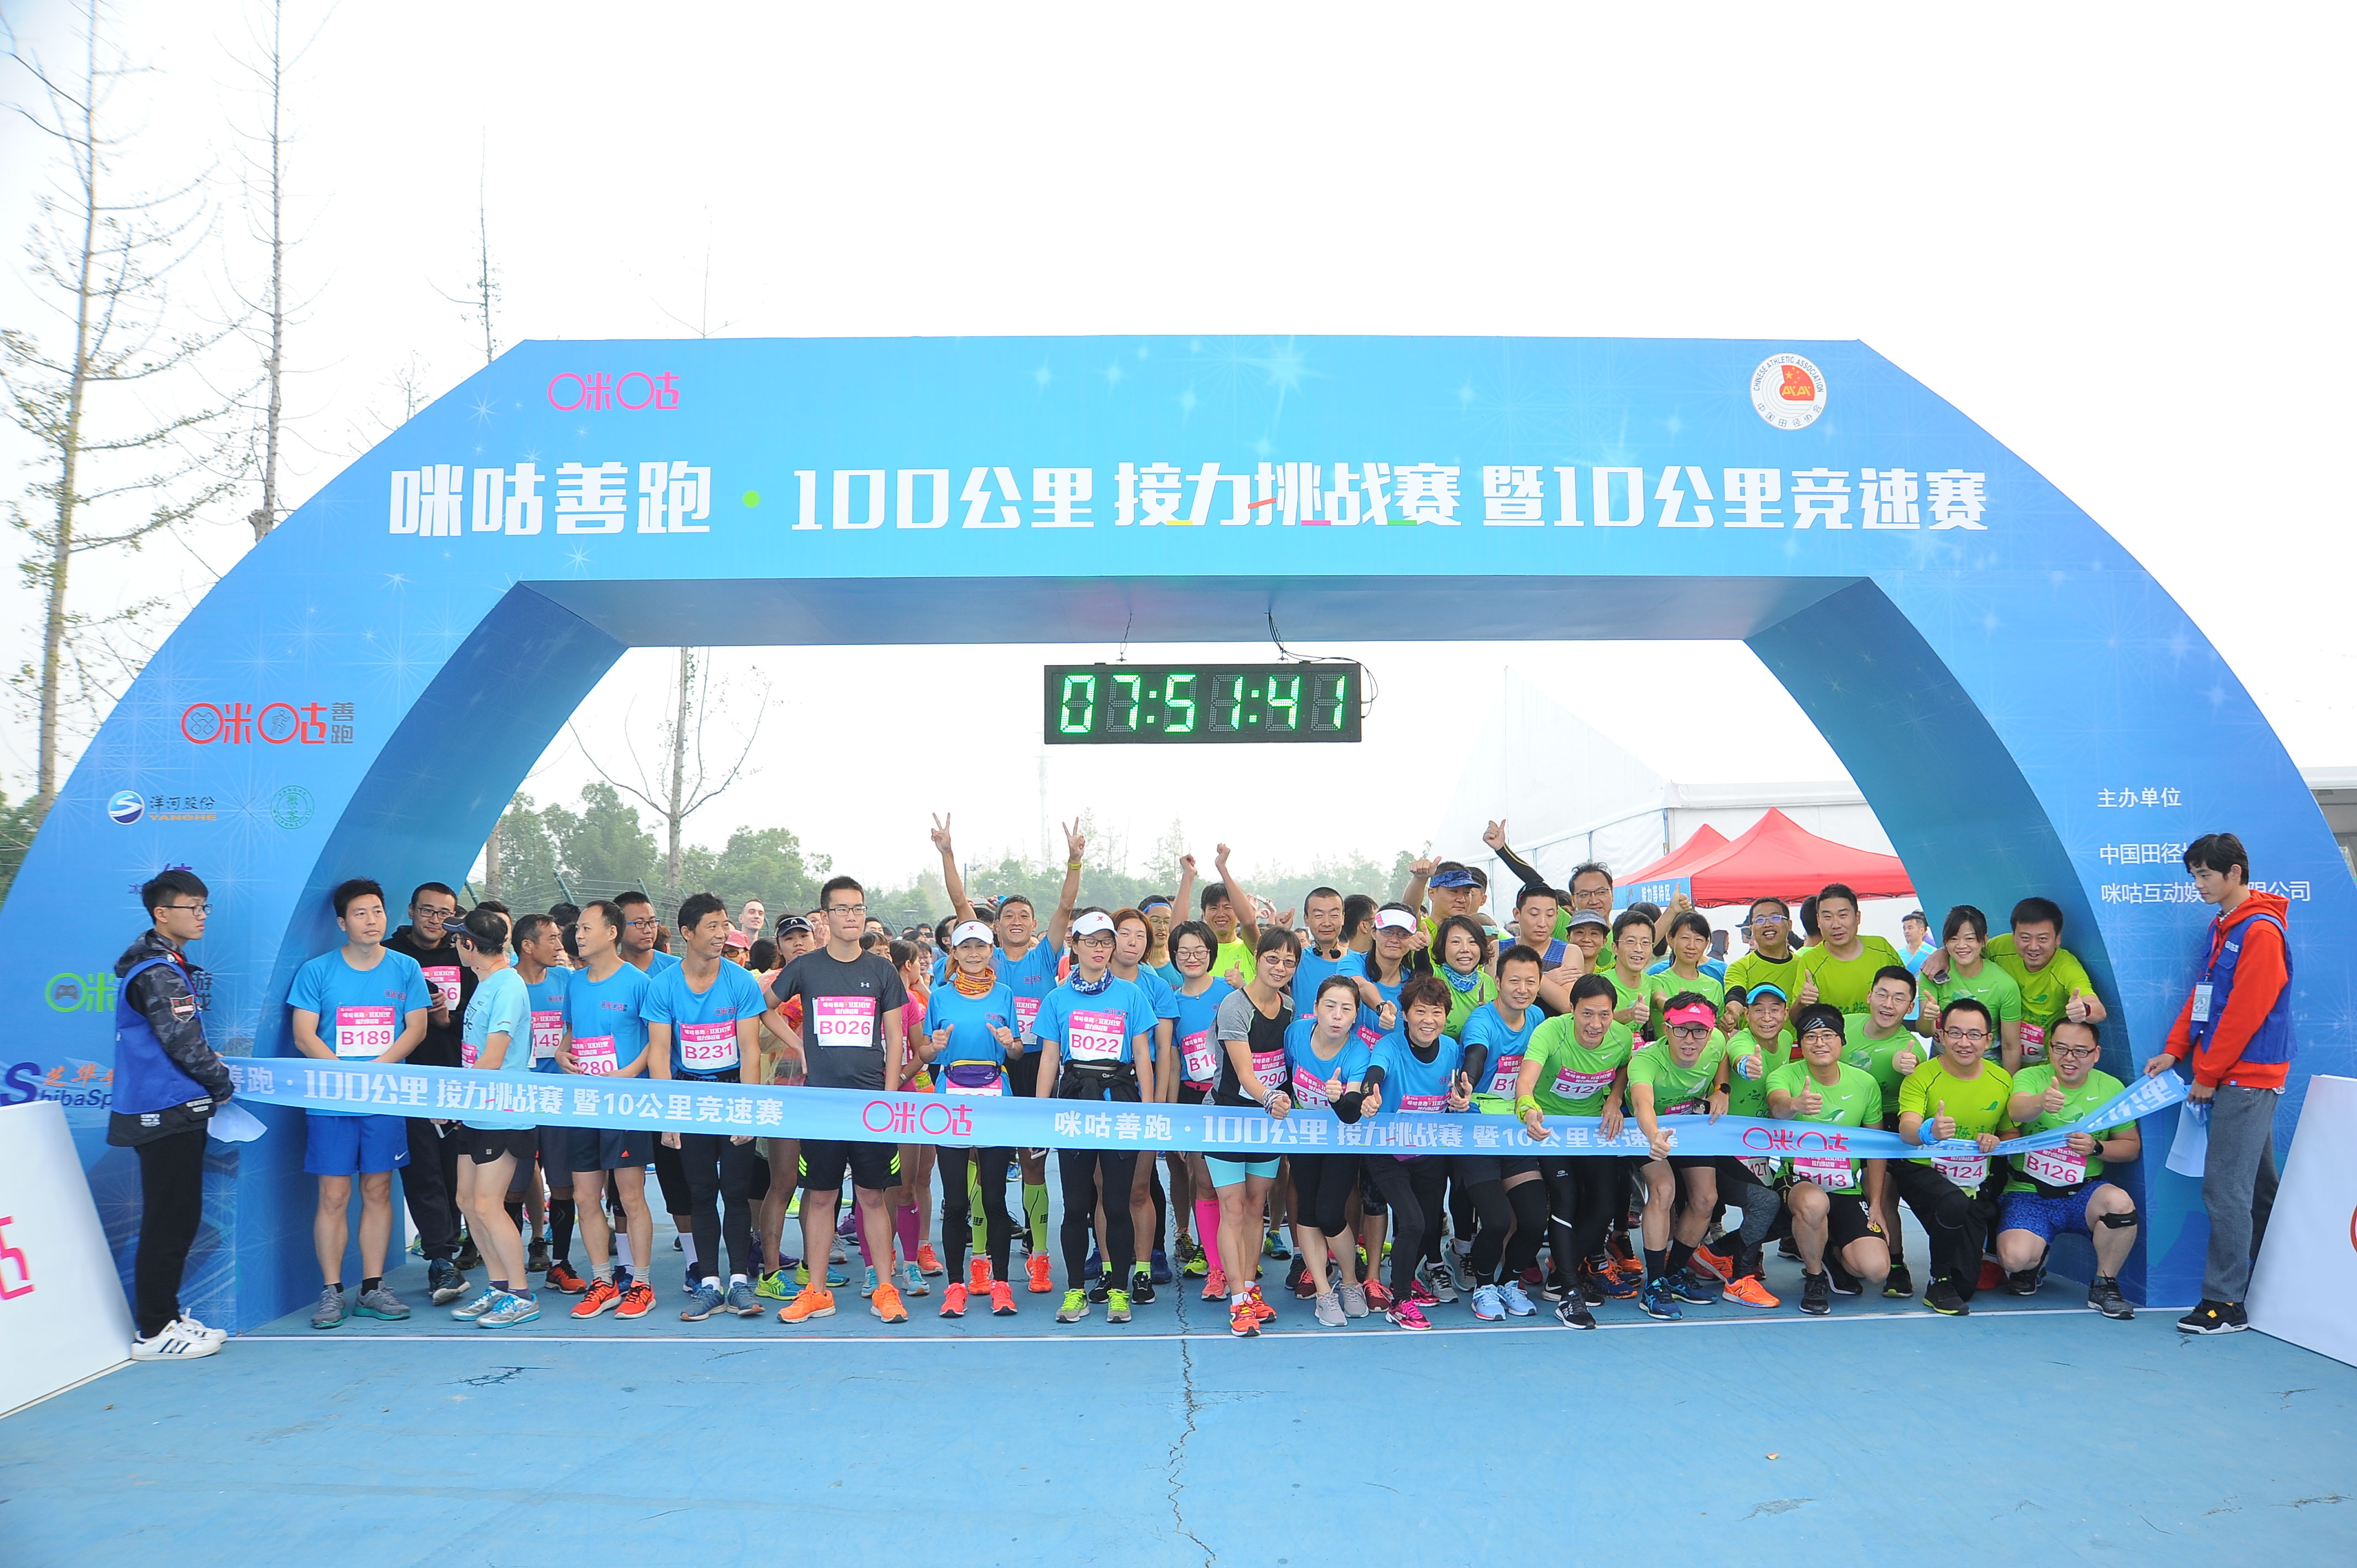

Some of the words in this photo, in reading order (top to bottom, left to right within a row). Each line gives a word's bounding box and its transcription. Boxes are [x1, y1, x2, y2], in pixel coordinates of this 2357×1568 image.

[1753, 366, 1768, 391] CHINESE
[1767, 356, 1794, 368] ATHLETIC
[1795, 359, 1824, 393] ASSOCIATION
[389, 461, 711, 537] 咪咕善跑
[792, 466, 1094, 532] 100公里
[1114, 461, 1463, 527] 接力挑战赛
[1483, 465, 1989, 531] 暨10公里竞速赛
[1059, 673, 1346, 734] 07:51:41
[150, 795, 215, 811] 洋河股份
[2097, 787, 2183, 808] 主办单位
[1641, 884, 1671, 902] 接力等待区
[342, 1030, 390, 1045] B189
[820, 1020, 871, 1035] B026
[685, 1043, 732, 1059] B231
[1072, 1034, 1119, 1053] B022
[303, 1069, 429, 1107] 100公里
[436, 1079, 564, 1115] 接力挑战赛
[573, 1087, 784, 1126] 暨10公里竞速赛
[1054, 1110, 1172, 1141] 咪咕善跑
[1201, 1115, 1329, 1146] 100公里
[1336, 1120, 1464, 1148] 接力挑战赛
[1933, 1163, 1983, 1178] B124
[2027, 1156, 2078, 1183] B126
